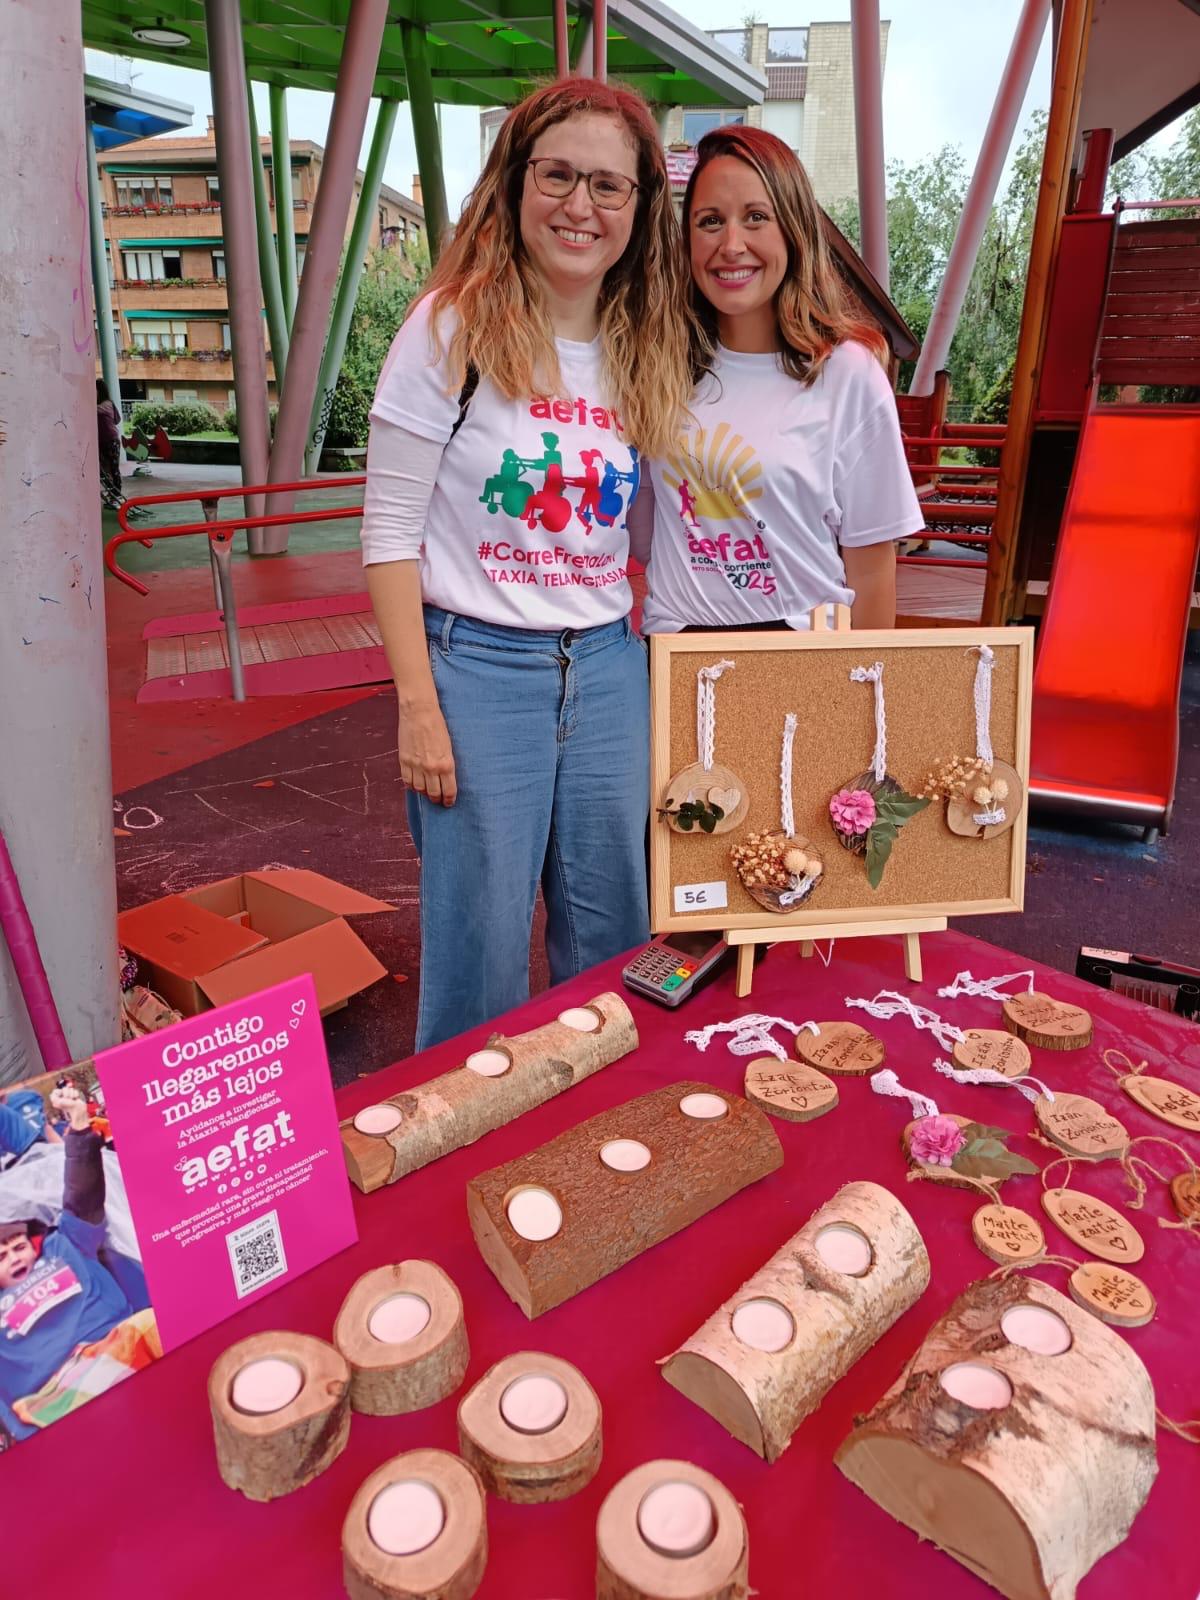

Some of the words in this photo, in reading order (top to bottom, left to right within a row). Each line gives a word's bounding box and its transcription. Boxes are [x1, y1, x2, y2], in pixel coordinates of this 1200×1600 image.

[689, 533, 769, 561] aefat
[724, 562, 771, 571] corriente
[727, 570, 776, 595] 2025
[162, 1015, 264, 1068] Contigo
[812, 1040, 840, 1061] Izan
[972, 1041, 993, 1066] Izan
[142, 1030, 289, 1106] llegaremos
[755, 1072, 799, 1085] Izan
[162, 1087, 221, 1127] más
[224, 1060, 283, 1098] lejos
[177, 1141, 187, 1149] la
[189, 1125, 219, 1144] Ataxia
[220, 1096, 282, 1129] Telangiectasia
[179, 1114, 225, 1140] Ayúdanos
[226, 1109, 233, 1117] a
[233, 1090, 277, 1112] investigar
[1050, 1111, 1082, 1123] Izan
[181, 1110, 295, 1186] aefat
[151, 1230, 170, 1242] Una
[171, 1203, 221, 1233] enfermedad
[221, 1192, 242, 1208] rara,
[242, 1187, 255, 1198] sin
[255, 1176, 274, 1192] cura
[274, 1170, 283, 1181] ni
[283, 1149, 329, 1175] tratamiento,
[175, 1228, 191, 1241] que
[192, 1210, 225, 1233] provoca
[225, 1202, 241, 1213] una
[242, 1191, 265, 1207] grave
[265, 1164, 313, 1197] discapacidad
[181, 1222, 226, 1247] progresiva
[226, 1216, 232, 1224] y
[233, 1206, 251, 1219] más
[251, 1195, 275, 1212] riesgo
[275, 1188, 286, 1198] de
[285, 1175, 312, 1194] cáncer
[982, 1216, 1029, 1231] Maite
[1058, 1204, 1104, 1226] Maite
[988, 1230, 1039, 1244] zaitut
[1080, 1217, 1126, 1239] zaitut
[24, 1279, 59, 1307] 104
[1091, 1275, 1126, 1301] Maite
